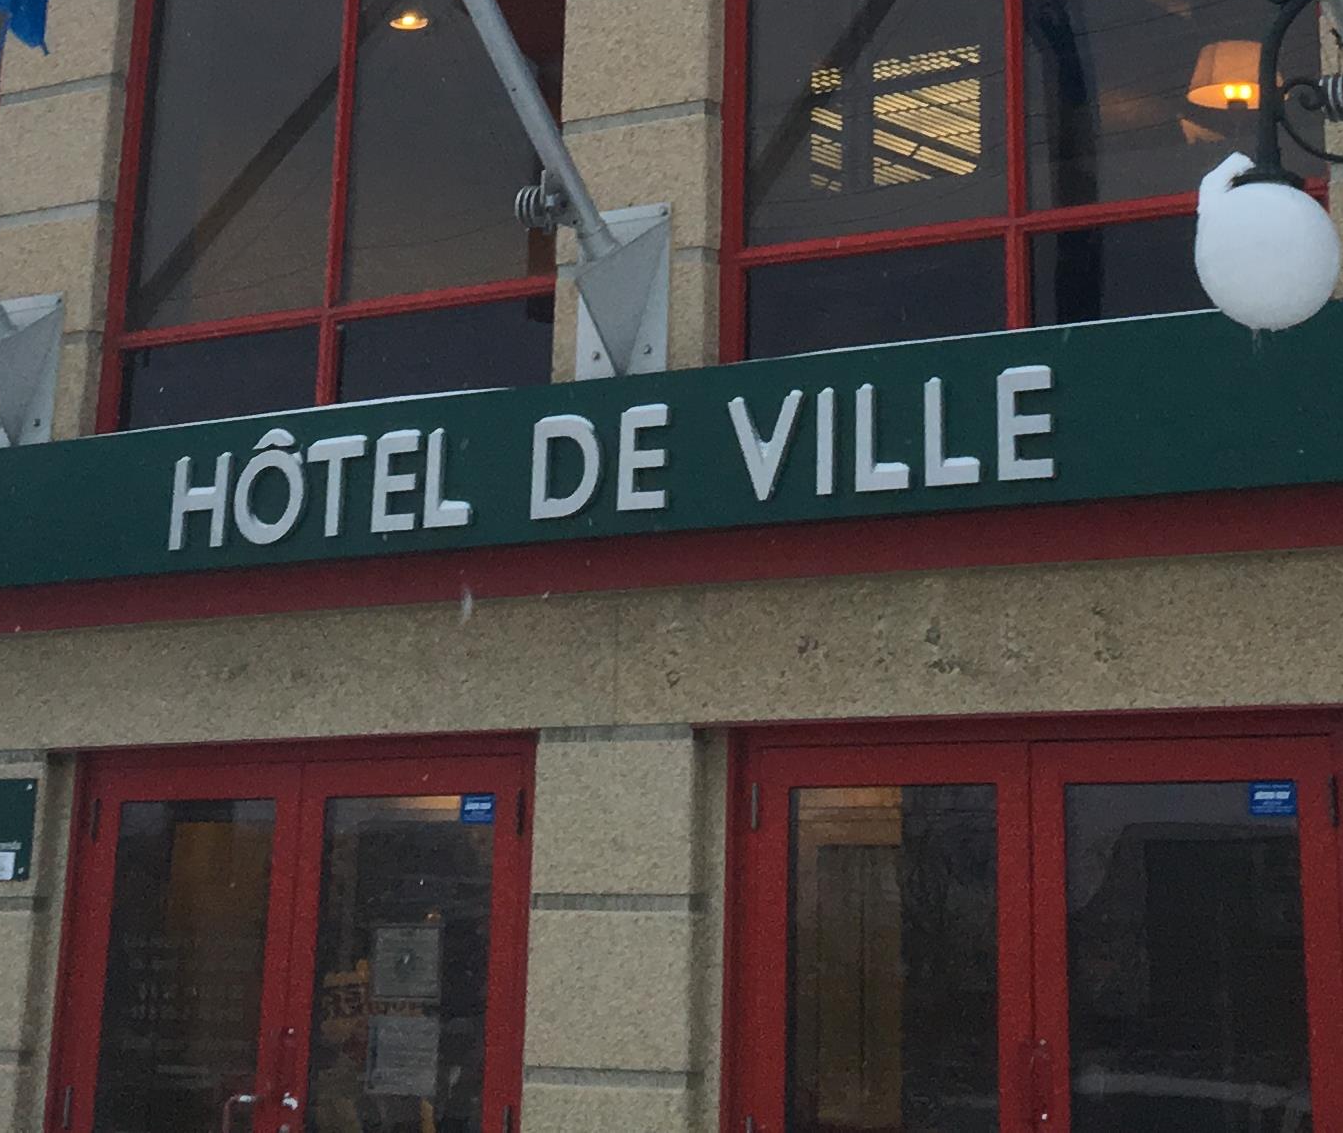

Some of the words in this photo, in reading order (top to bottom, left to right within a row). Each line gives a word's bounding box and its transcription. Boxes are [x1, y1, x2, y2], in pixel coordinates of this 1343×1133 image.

[167, 427, 473, 552] HÔTEL
[528, 403, 669, 521] DE
[727, 365, 1056, 502] VILLE
